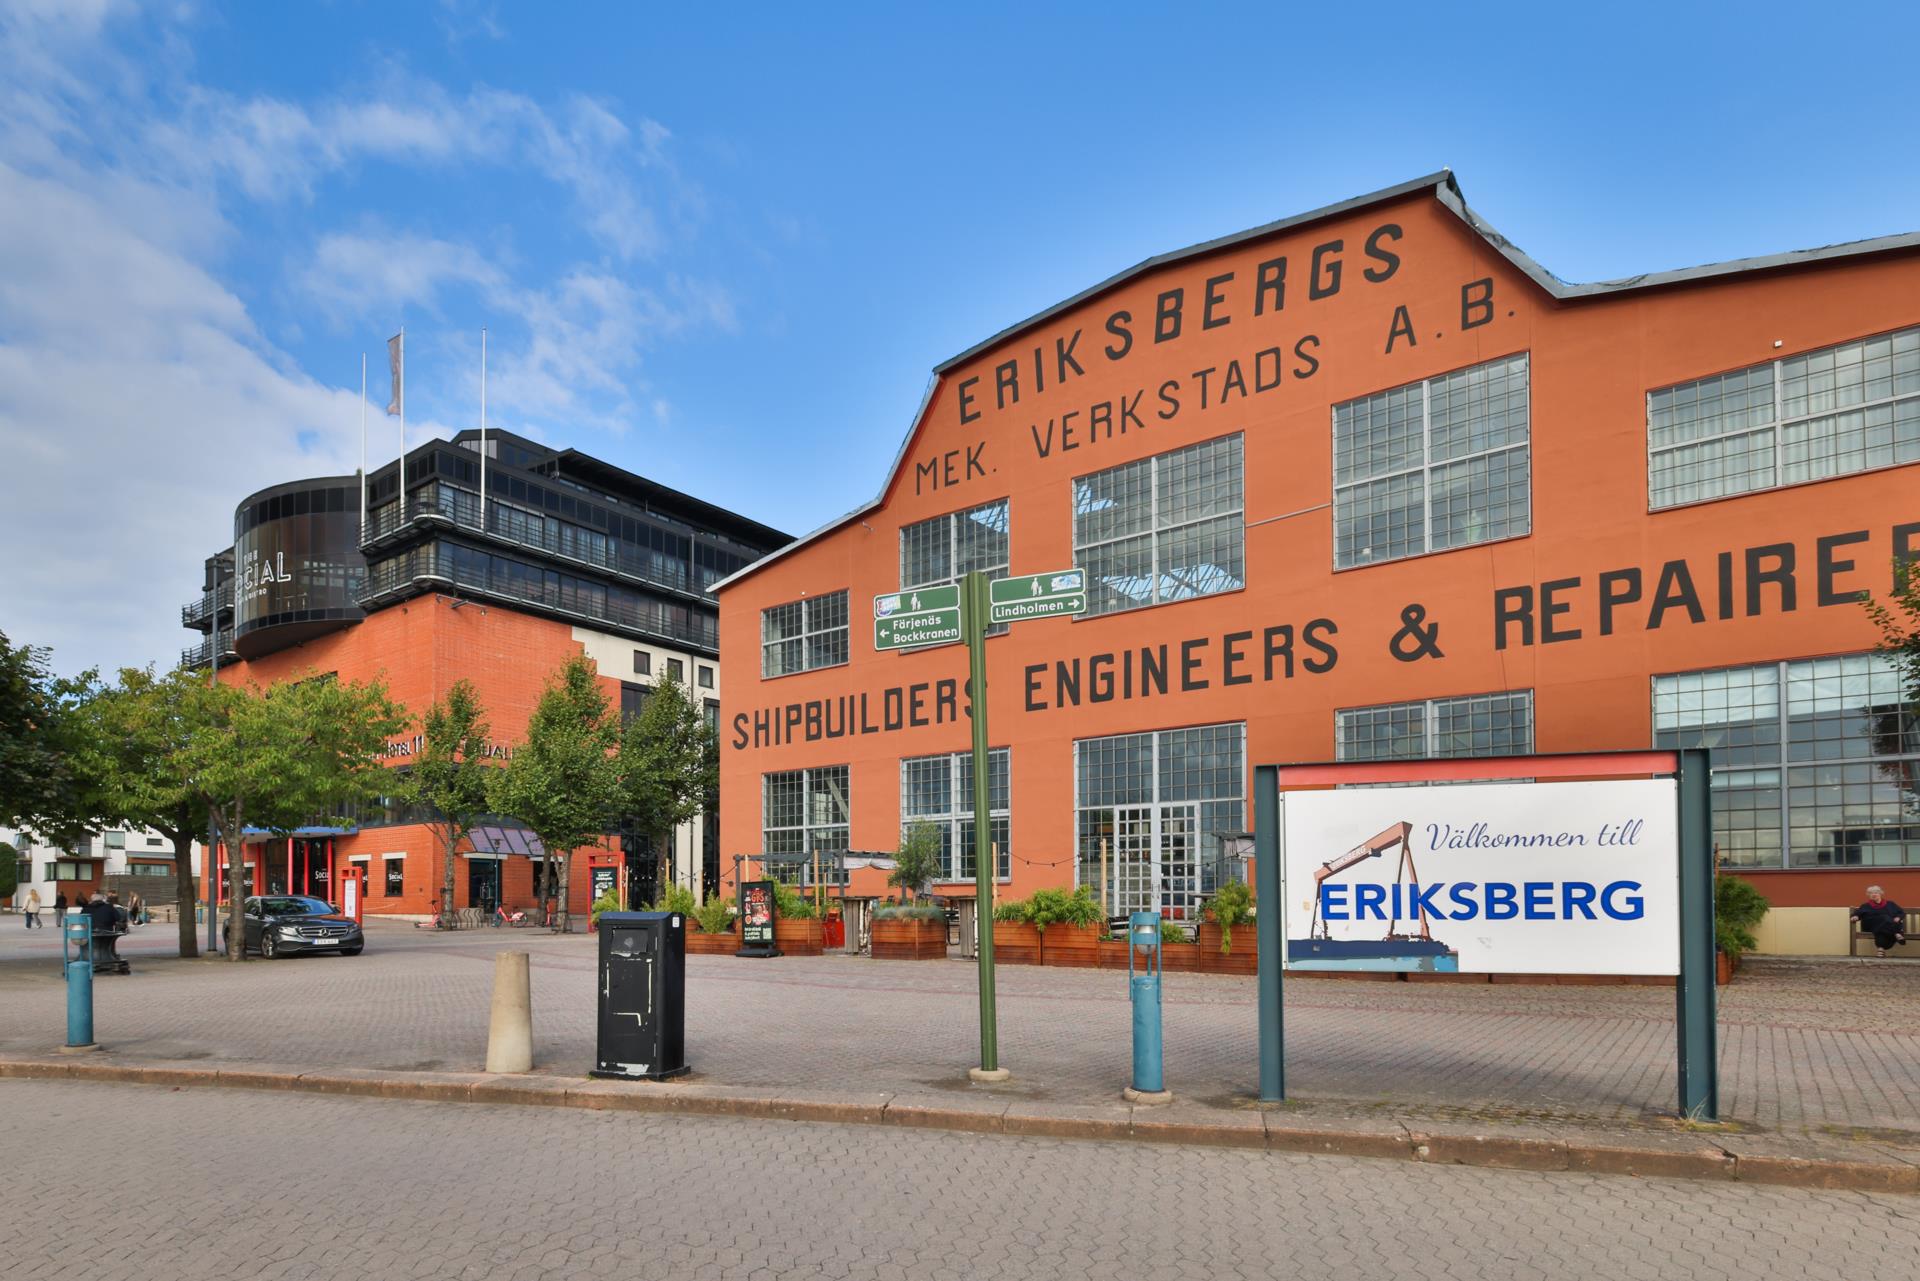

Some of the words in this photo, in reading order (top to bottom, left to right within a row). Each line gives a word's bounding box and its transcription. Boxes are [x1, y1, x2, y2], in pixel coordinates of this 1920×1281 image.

[958, 223, 1405, 425] ERIKSBERGS
[915, 441, 998, 496] MEK.
[1031, 334, 1321, 460] VERKSTADS
[893, 615, 942, 631] Färjenäs
[995, 602, 1064, 618] Lindholmen
[893, 628, 958, 643] Bockkranen
[1024, 618, 1339, 712] ENGINEERS
[1390, 603, 1444, 662] &
[1426, 822, 1589, 851] Välkommen
[1597, 818, 1644, 847] till
[1320, 880, 1645, 922] ERIKSBERG
